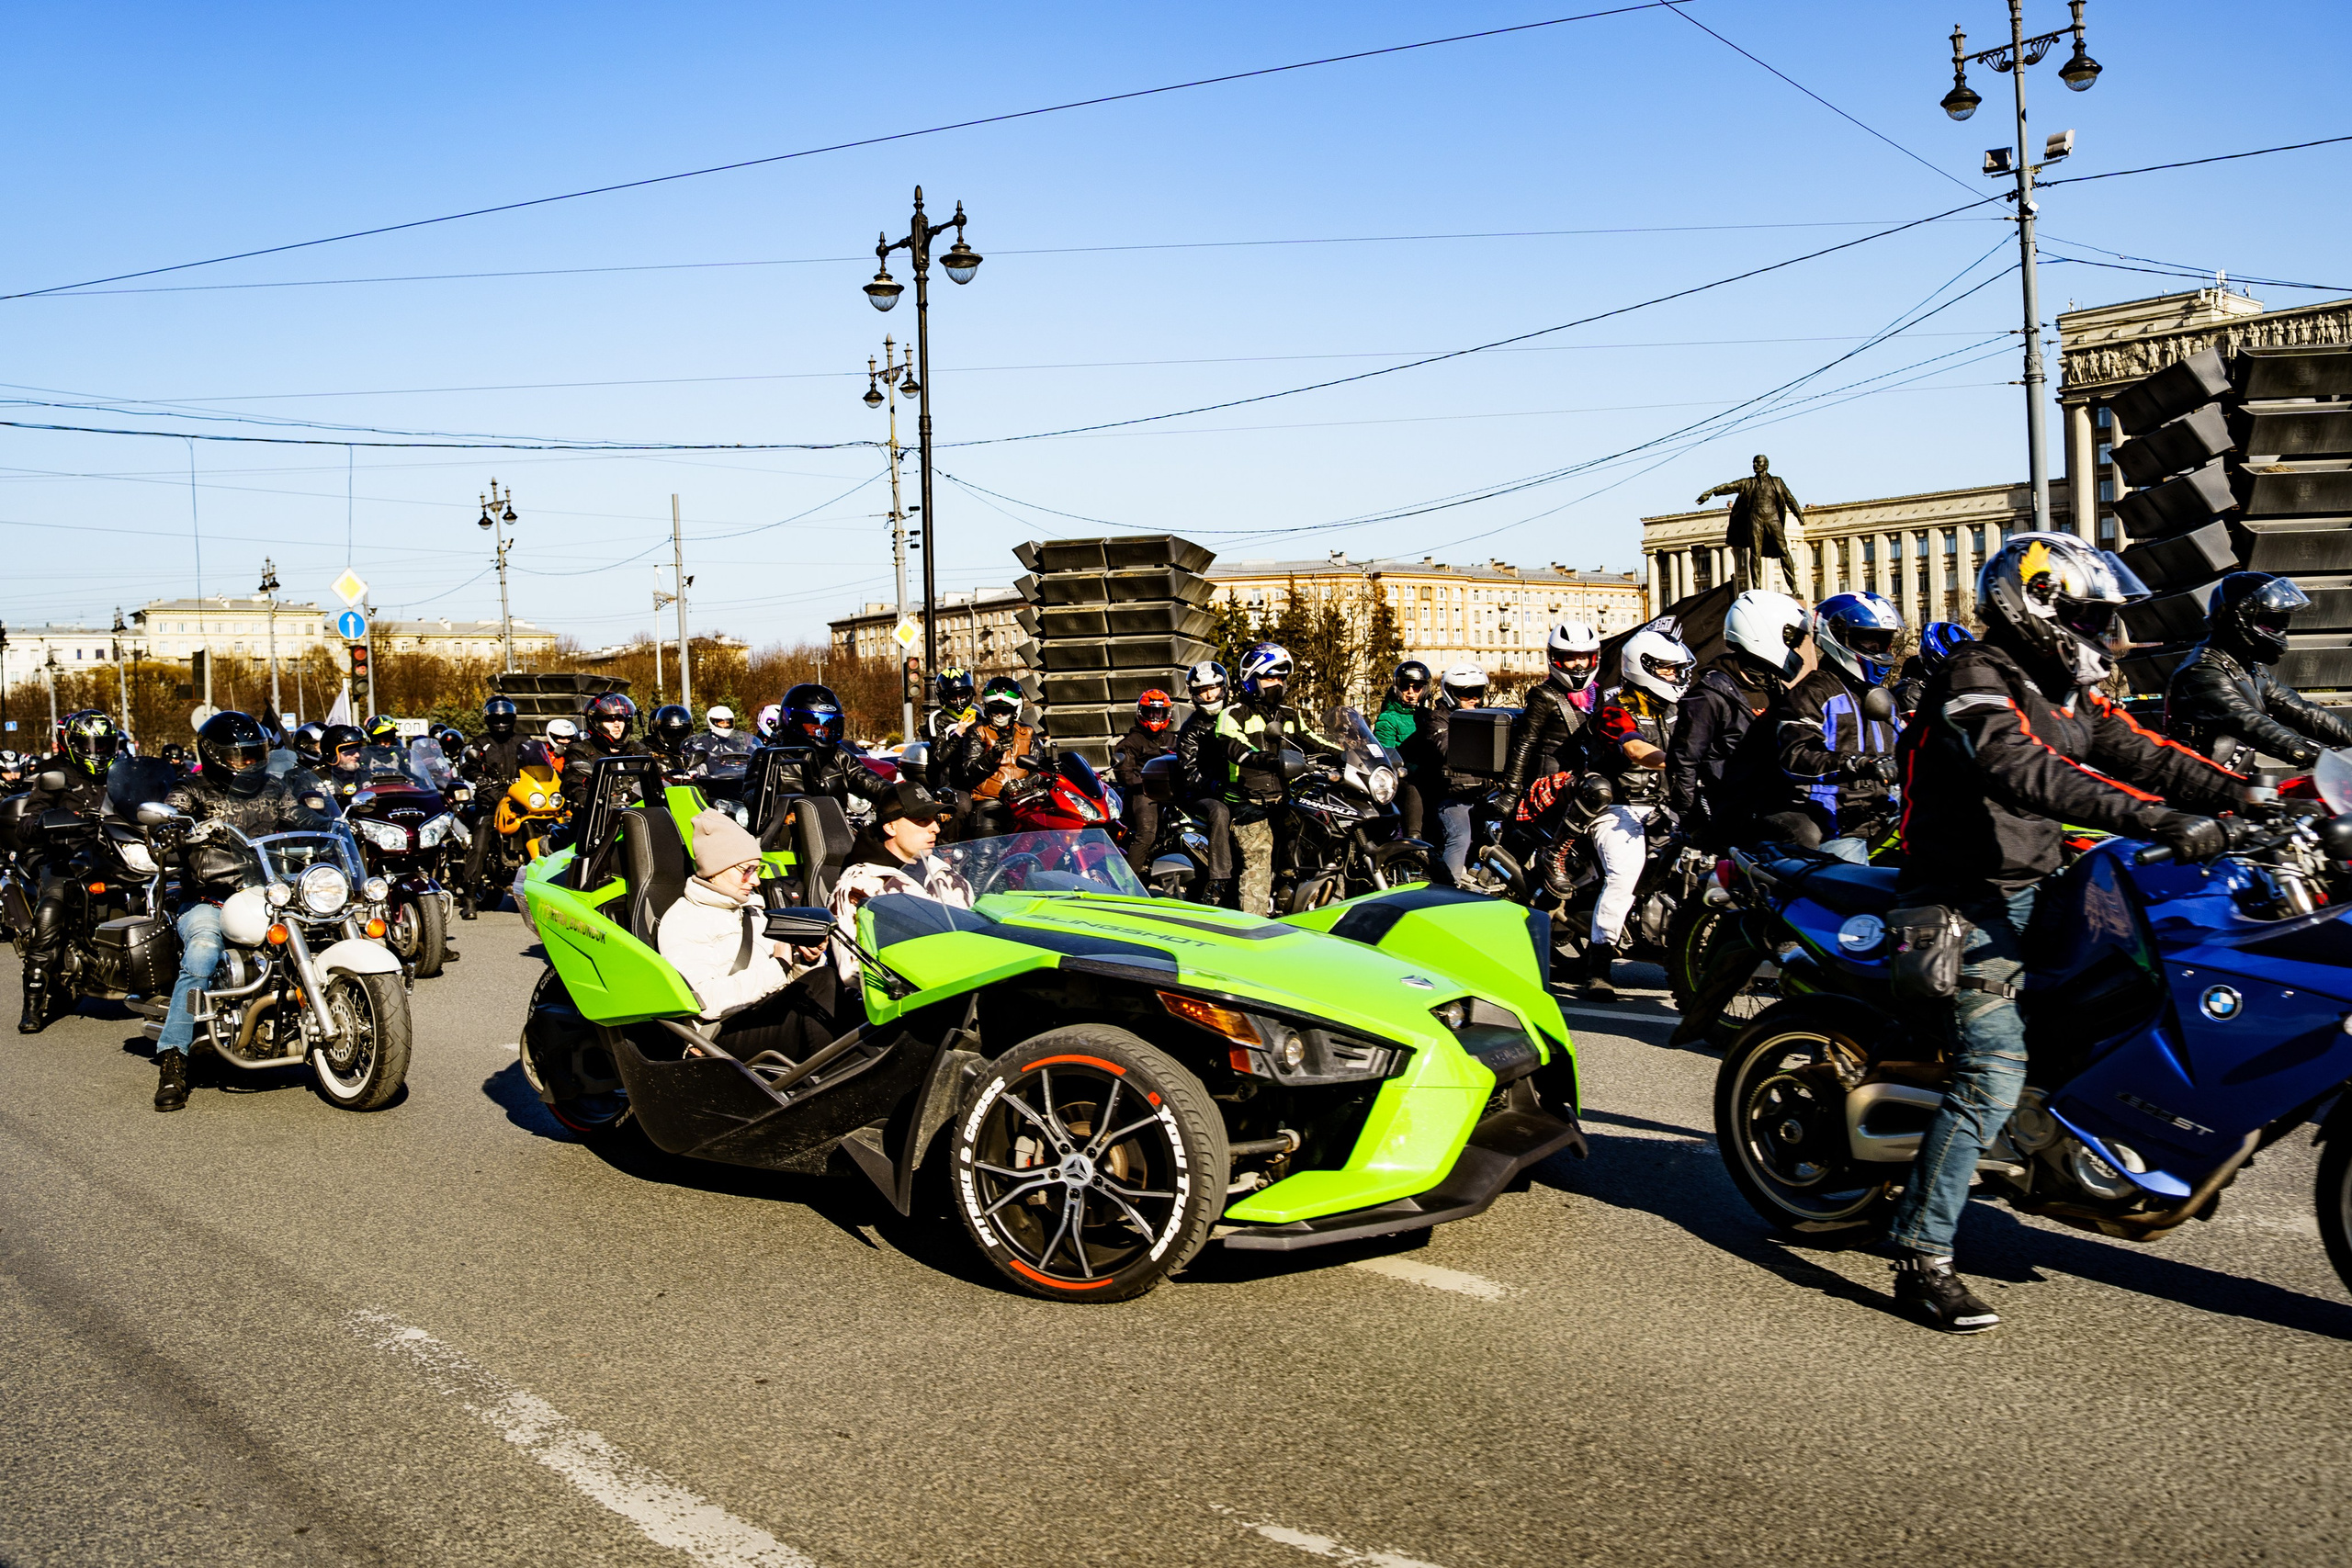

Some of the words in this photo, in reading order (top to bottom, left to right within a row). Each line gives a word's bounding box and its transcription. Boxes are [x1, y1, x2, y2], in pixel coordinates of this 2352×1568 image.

[396, 722, 421, 733] ТОП
[1298, 796, 1359, 816] TRANSALP
[1026, 914, 1217, 948] SLINGSHOT
[963, 1076, 1006, 1144] CROSS
